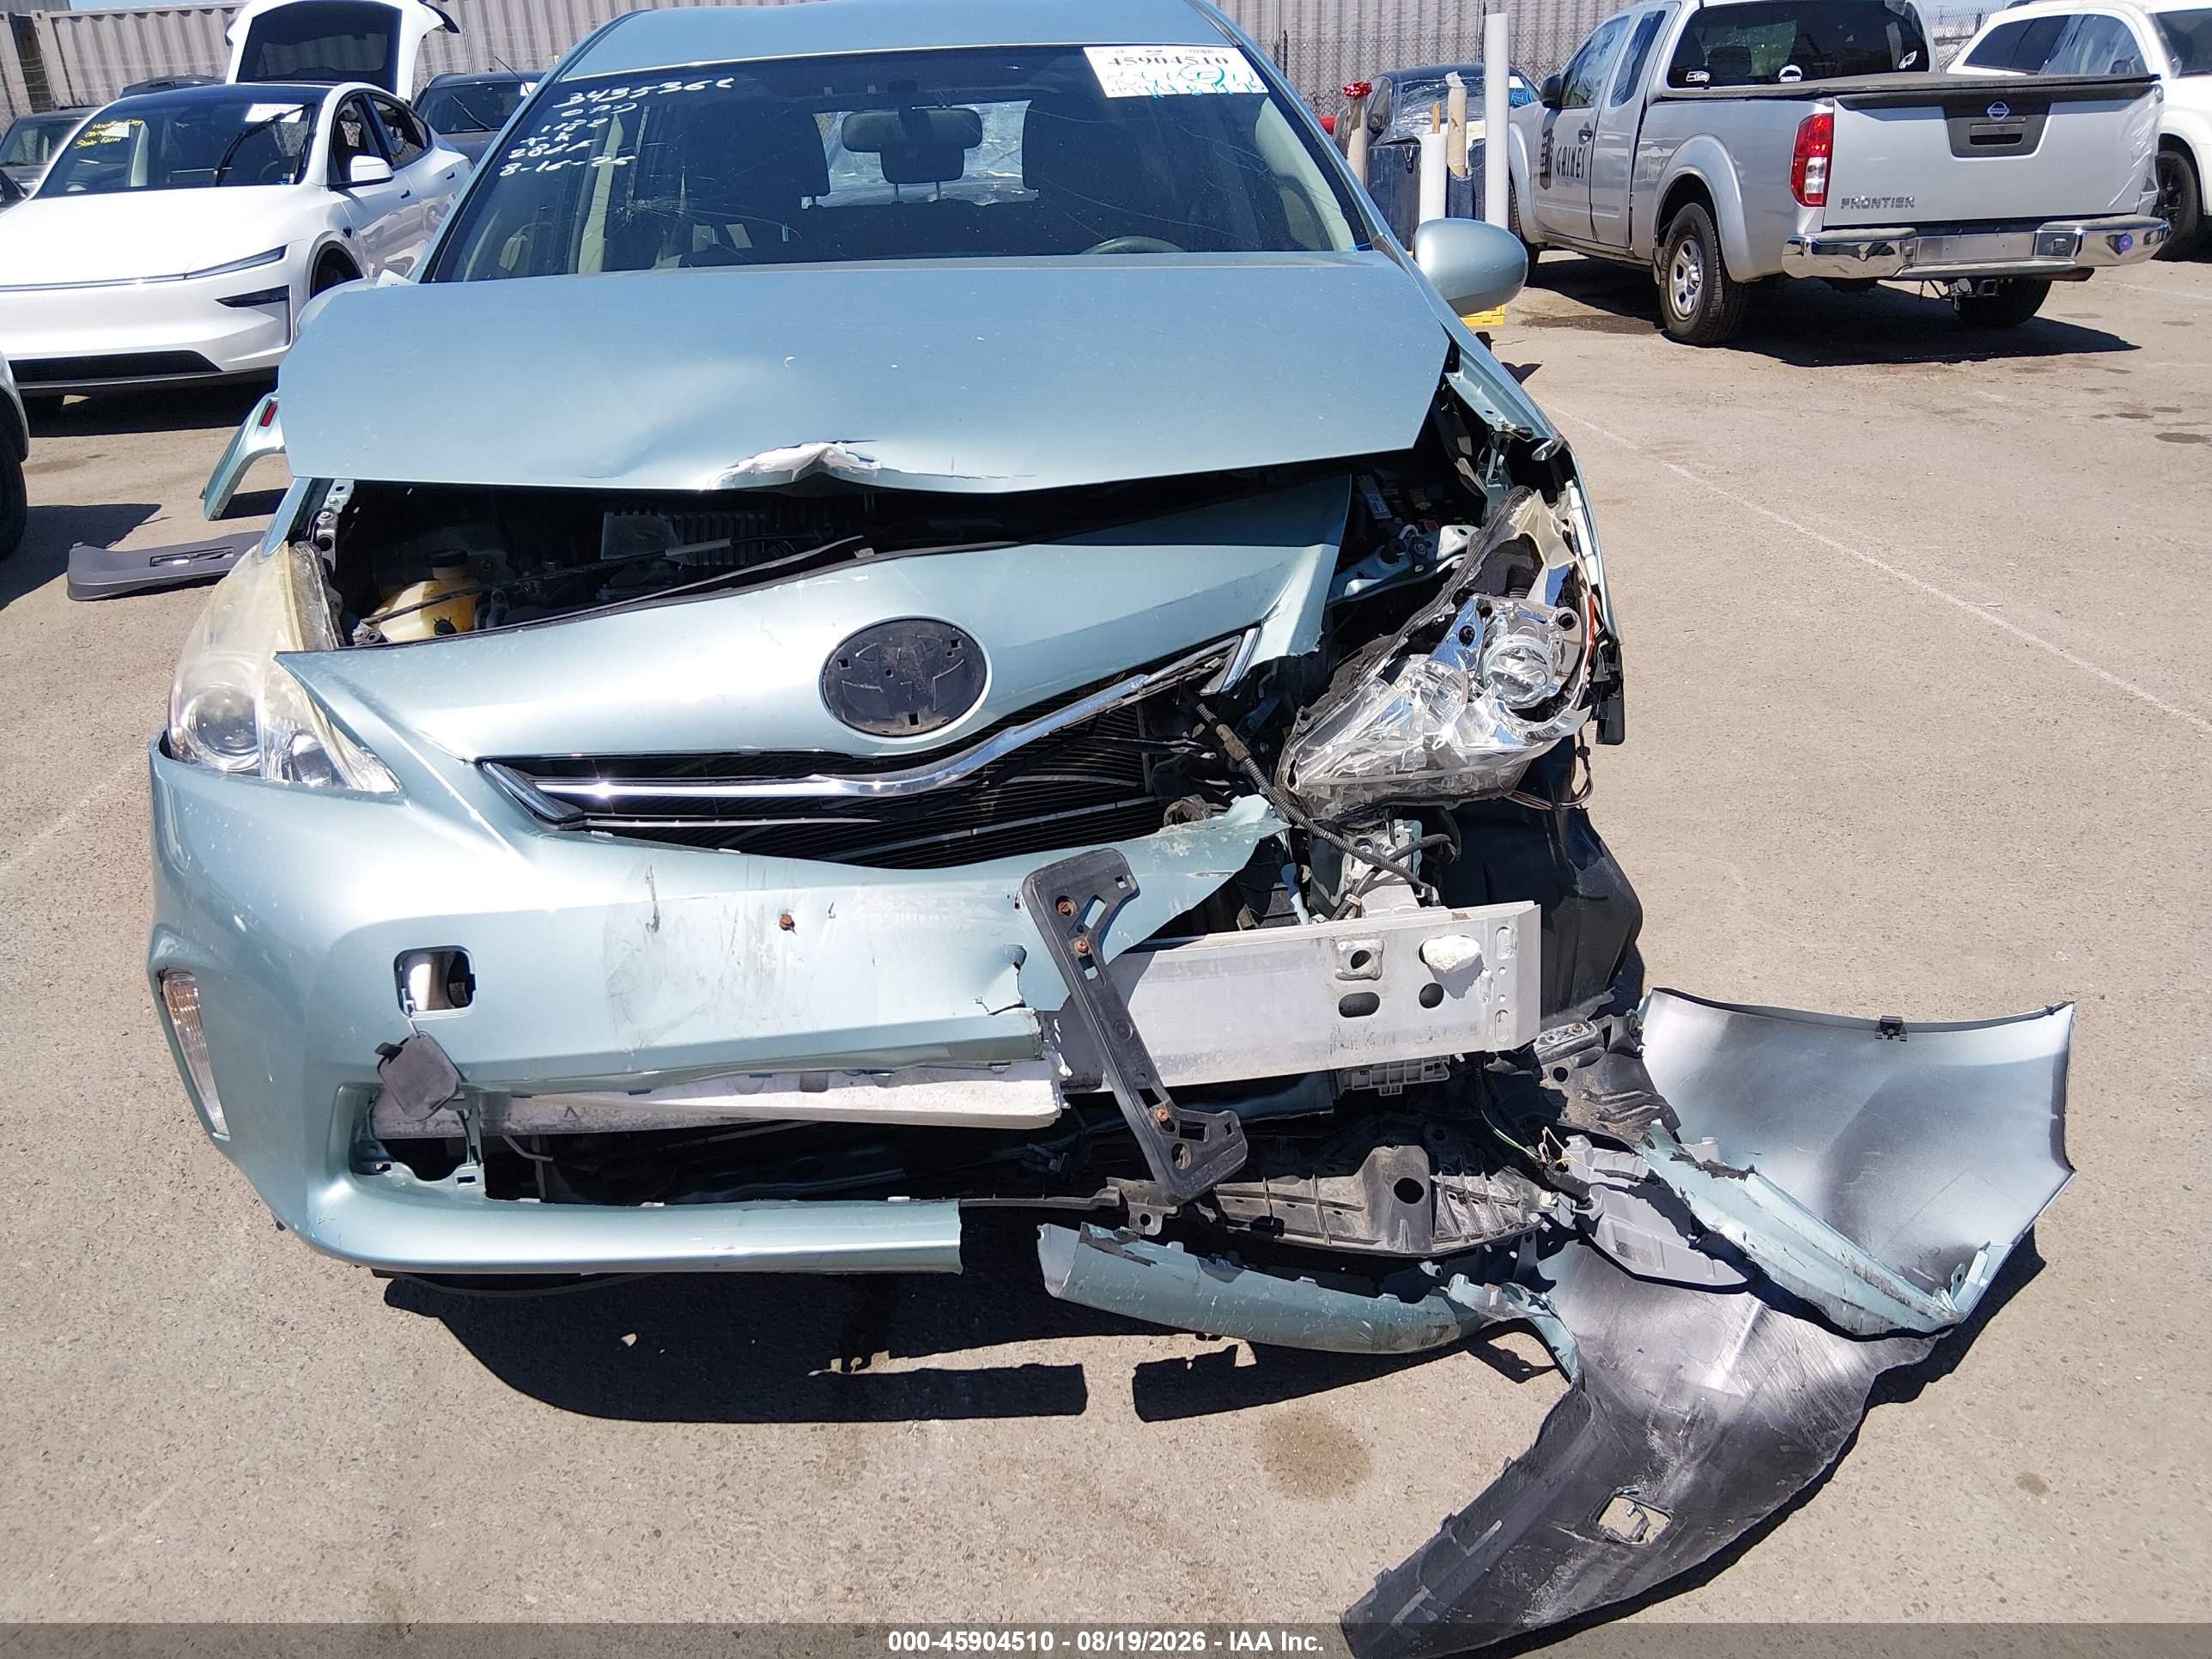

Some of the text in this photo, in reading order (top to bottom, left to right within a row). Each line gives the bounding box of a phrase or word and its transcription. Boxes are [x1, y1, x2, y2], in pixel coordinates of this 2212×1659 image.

[1108, 55, 1229, 66] 45904510
[1556, 145, 1587, 179] GAINES
[1840, 195, 1916, 210] FRONTIER
